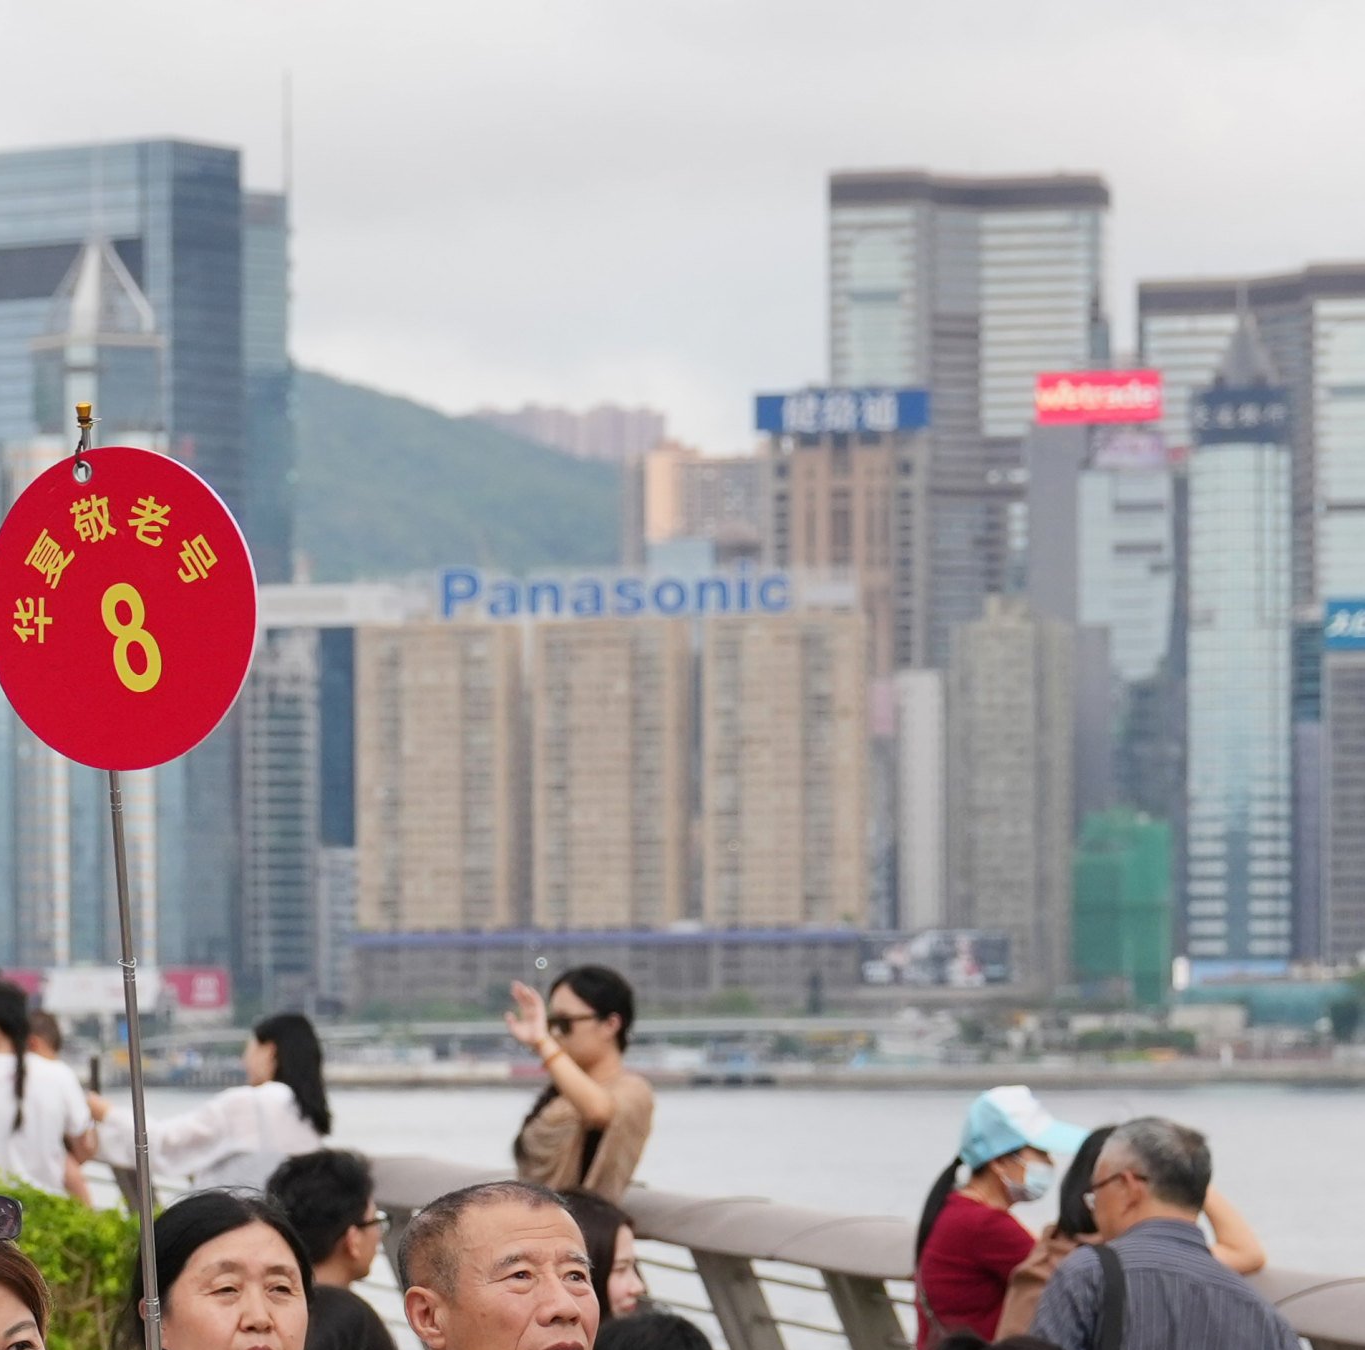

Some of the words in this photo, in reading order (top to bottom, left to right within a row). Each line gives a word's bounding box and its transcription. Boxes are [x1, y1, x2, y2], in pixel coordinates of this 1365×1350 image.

[13, 494, 218, 644] 华夏敬老号
[441, 561, 791, 621] Panasonic
[101, 582, 162, 693] 8
